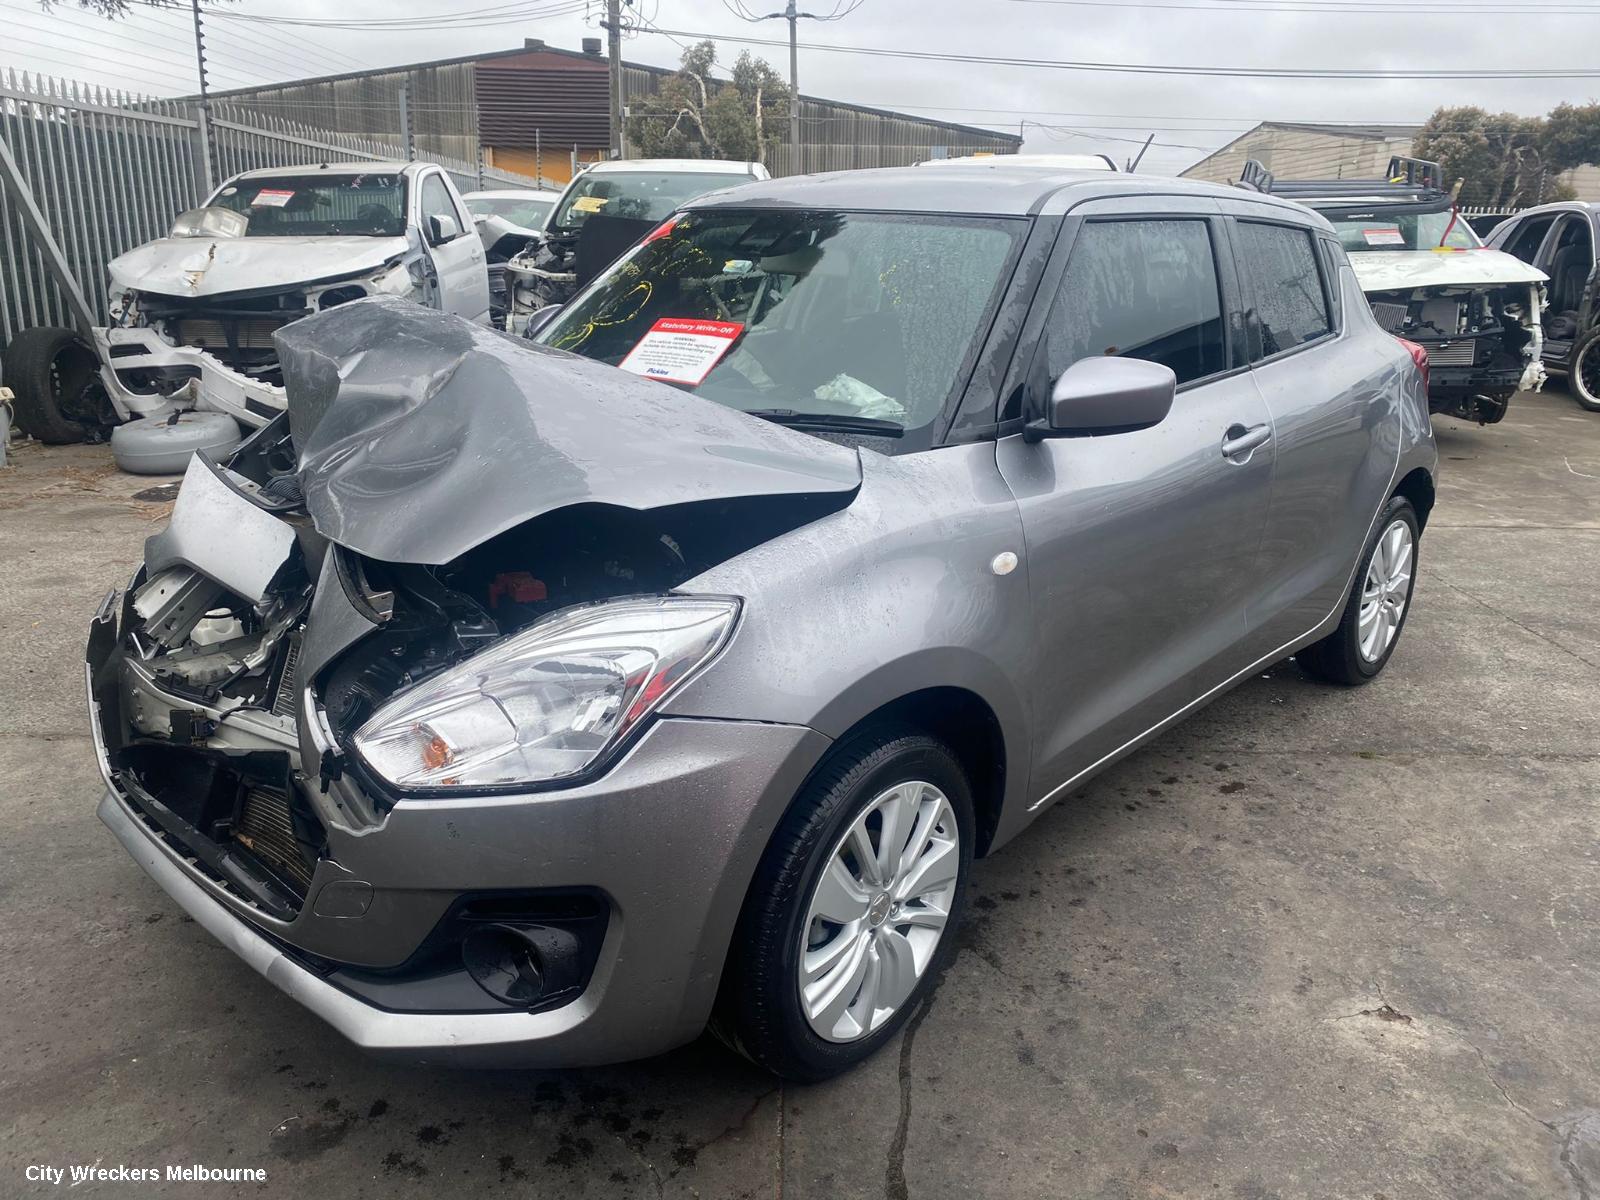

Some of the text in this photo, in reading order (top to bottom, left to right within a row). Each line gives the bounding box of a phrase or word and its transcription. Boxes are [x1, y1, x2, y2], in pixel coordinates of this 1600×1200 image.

[660, 322, 735, 334] Statutory Write-Off
[646, 367, 669, 376] Pickles
